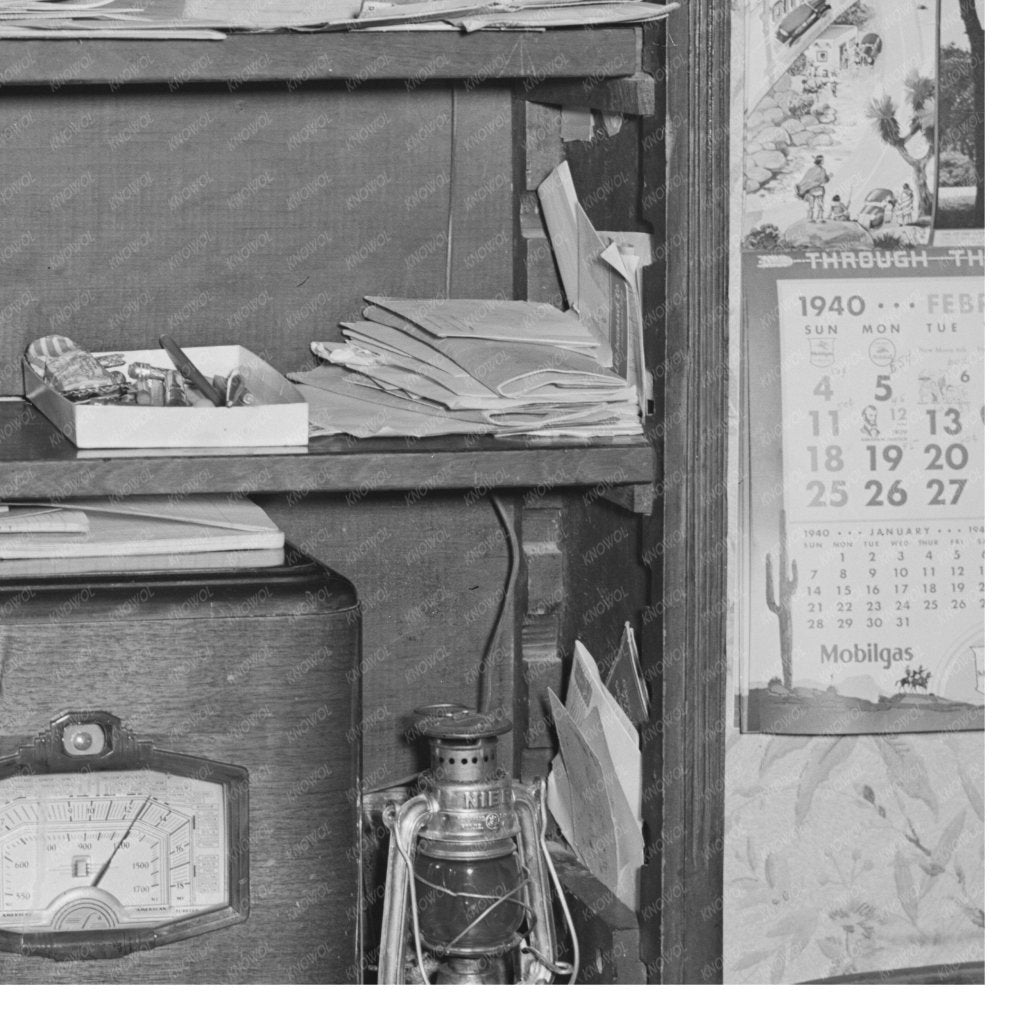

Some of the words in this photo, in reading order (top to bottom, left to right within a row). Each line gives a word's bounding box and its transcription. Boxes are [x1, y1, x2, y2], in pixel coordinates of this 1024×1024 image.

[805, 251, 928, 269] THROUGH
[798, 295, 865, 316] 1940
[804, 325, 838, 335] SUN
[862, 324, 900, 334] MON
[926, 322, 958, 333] TUE
[813, 376, 834, 401] 4
[874, 376, 893, 401] 5
[960, 370, 970, 383] 6
[808, 410, 839, 436] 11
[891, 408, 907, 421] 12
[926, 408, 962, 435] 13
[806, 445, 844, 472] 18
[866, 444, 903, 471] 19
[924, 443, 969, 470] 20
[806, 480, 848, 507] 25
[864, 480, 908, 506] 26
[926, 479, 968, 505] 27
[804, 530, 830, 538] 1940
[869, 528, 931, 537] JANUARY
[840, 552, 845, 563] 1
[868, 552, 876, 562] 2
[897, 551, 904, 561] 3
[925, 550, 933, 560] 4
[953, 550, 960, 560] 5
[810, 570, 818, 580] 7
[839, 569, 847, 579] 8
[869, 568, 876, 578] 9
[893, 568, 908, 578] 10
[922, 567, 935, 577] 11
[951, 566, 965, 576] 12
[807, 586, 821, 596] 14
[836, 585, 851, 596] 15
[866, 584, 880, 595] 16
[894, 584, 909, 594] 17
[923, 583, 936, 594] 18
[951, 582, 965, 593] 19
[808, 603, 822, 612] 21
[836, 602, 852, 612] 22
[866, 601, 882, 612] 23
[895, 600, 910, 611] 24
[923, 600, 938, 610] 25
[951, 599, 966, 609] 26
[808, 619, 824, 629] 28
[836, 618, 853, 629] 29
[866, 617, 883, 628] 30
[896, 617, 910, 627] 31
[820, 643, 914, 670] Mobilgas
